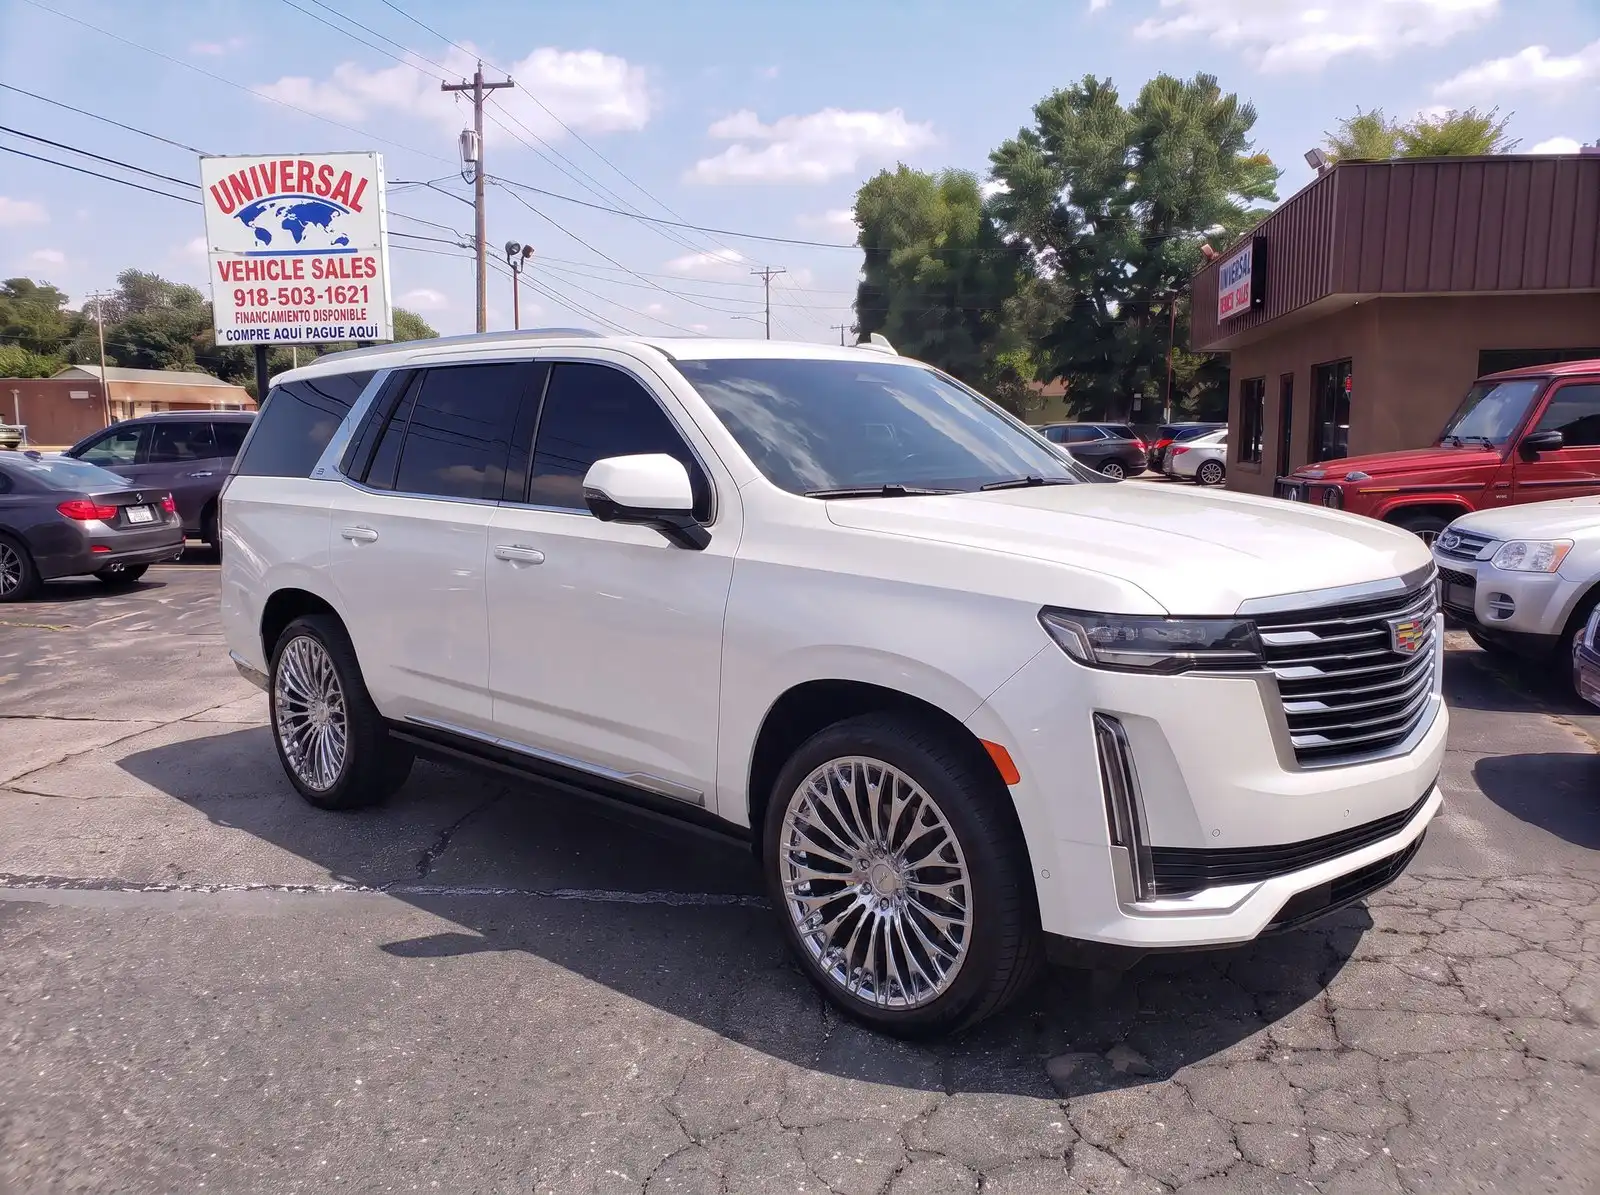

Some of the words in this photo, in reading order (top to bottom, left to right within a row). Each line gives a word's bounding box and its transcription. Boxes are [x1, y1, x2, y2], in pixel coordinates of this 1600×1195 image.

[210, 160, 369, 214] UNIVERSAL
[217, 259, 304, 282] VEHICLE
[311, 257, 377, 280] SALES
[233, 285, 369, 307] 918-503-1621
[235, 309, 311, 324] FINANCIAMIENTO
[313, 308, 367, 322] DISPONIBLE
[226, 328, 270, 341] COMPRE
[306, 326, 345, 339] PAGUE
